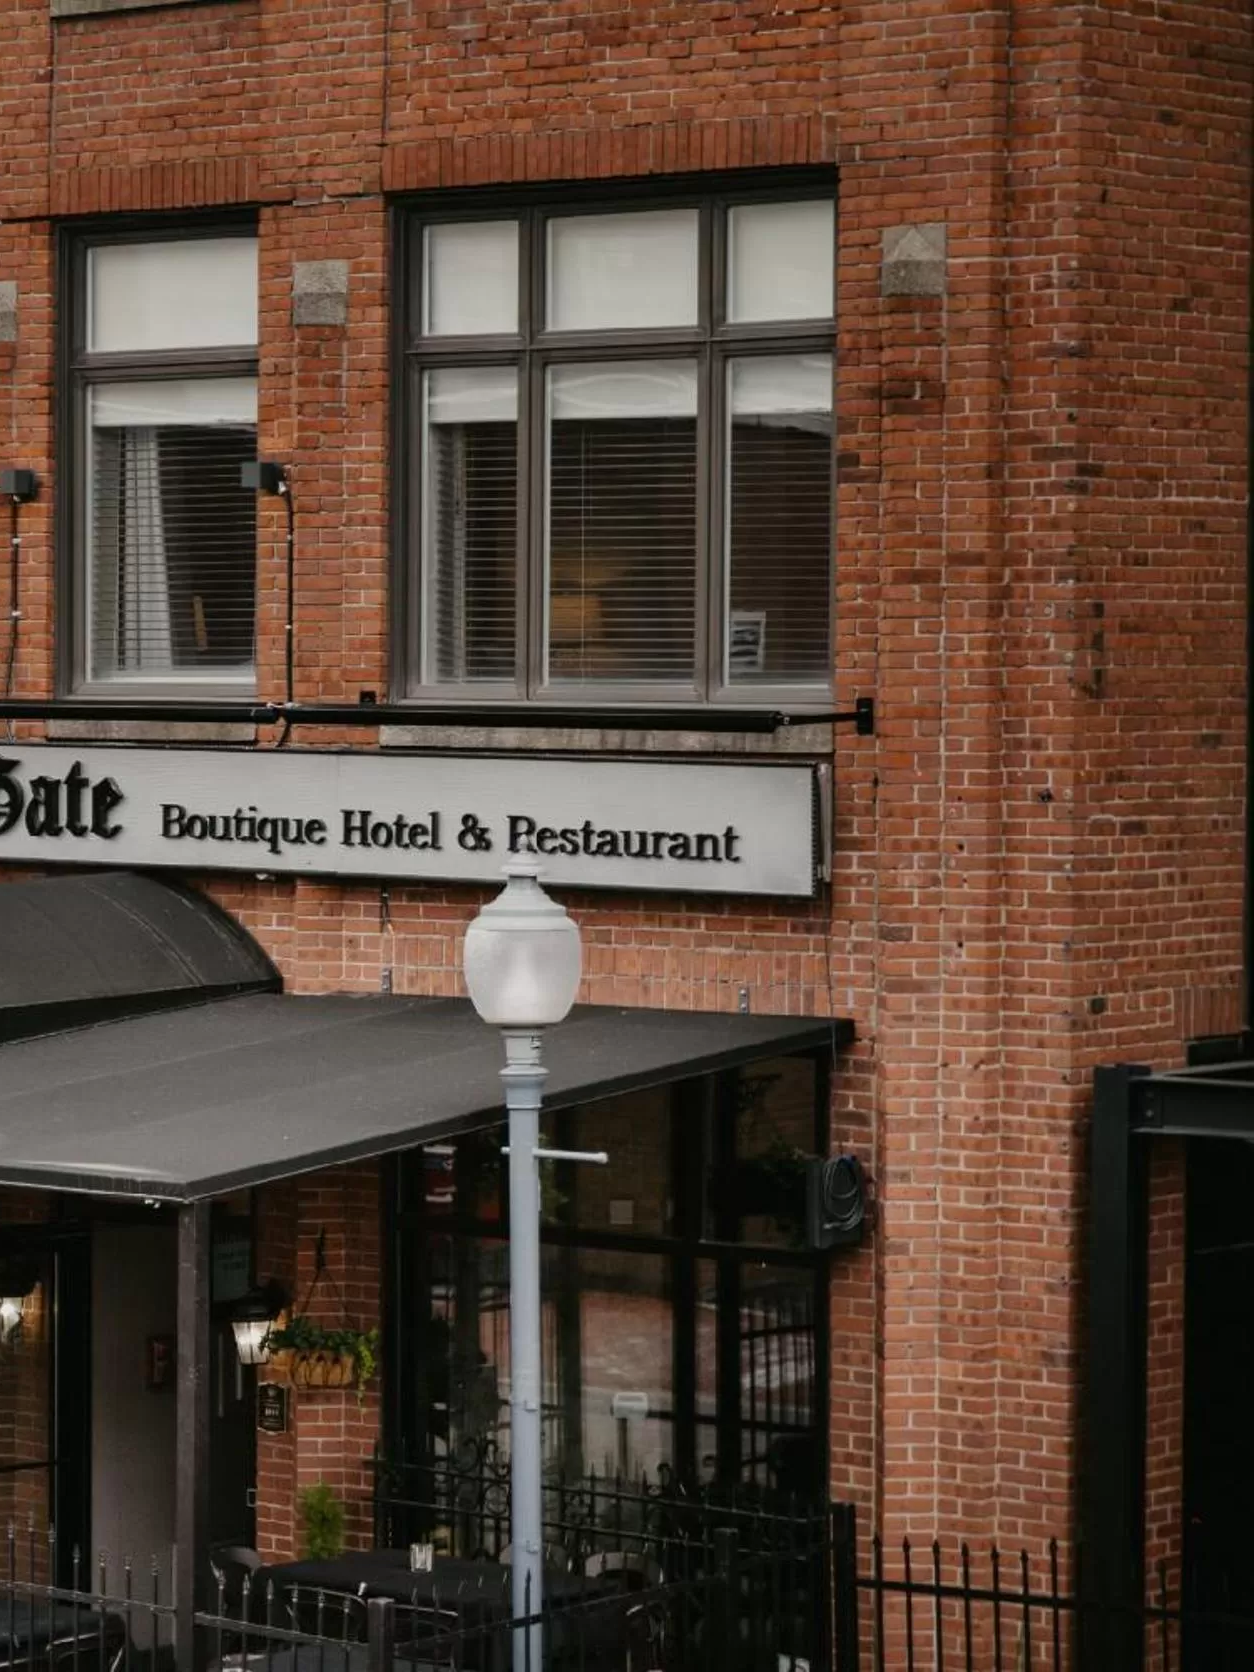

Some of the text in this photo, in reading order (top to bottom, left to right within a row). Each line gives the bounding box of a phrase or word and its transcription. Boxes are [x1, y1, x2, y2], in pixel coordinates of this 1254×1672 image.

[160, 803, 327, 855] Boutique
[340, 808, 441, 850] Hotel
[457, 813, 493, 852] &
[506, 814, 740, 863] Restaurant
